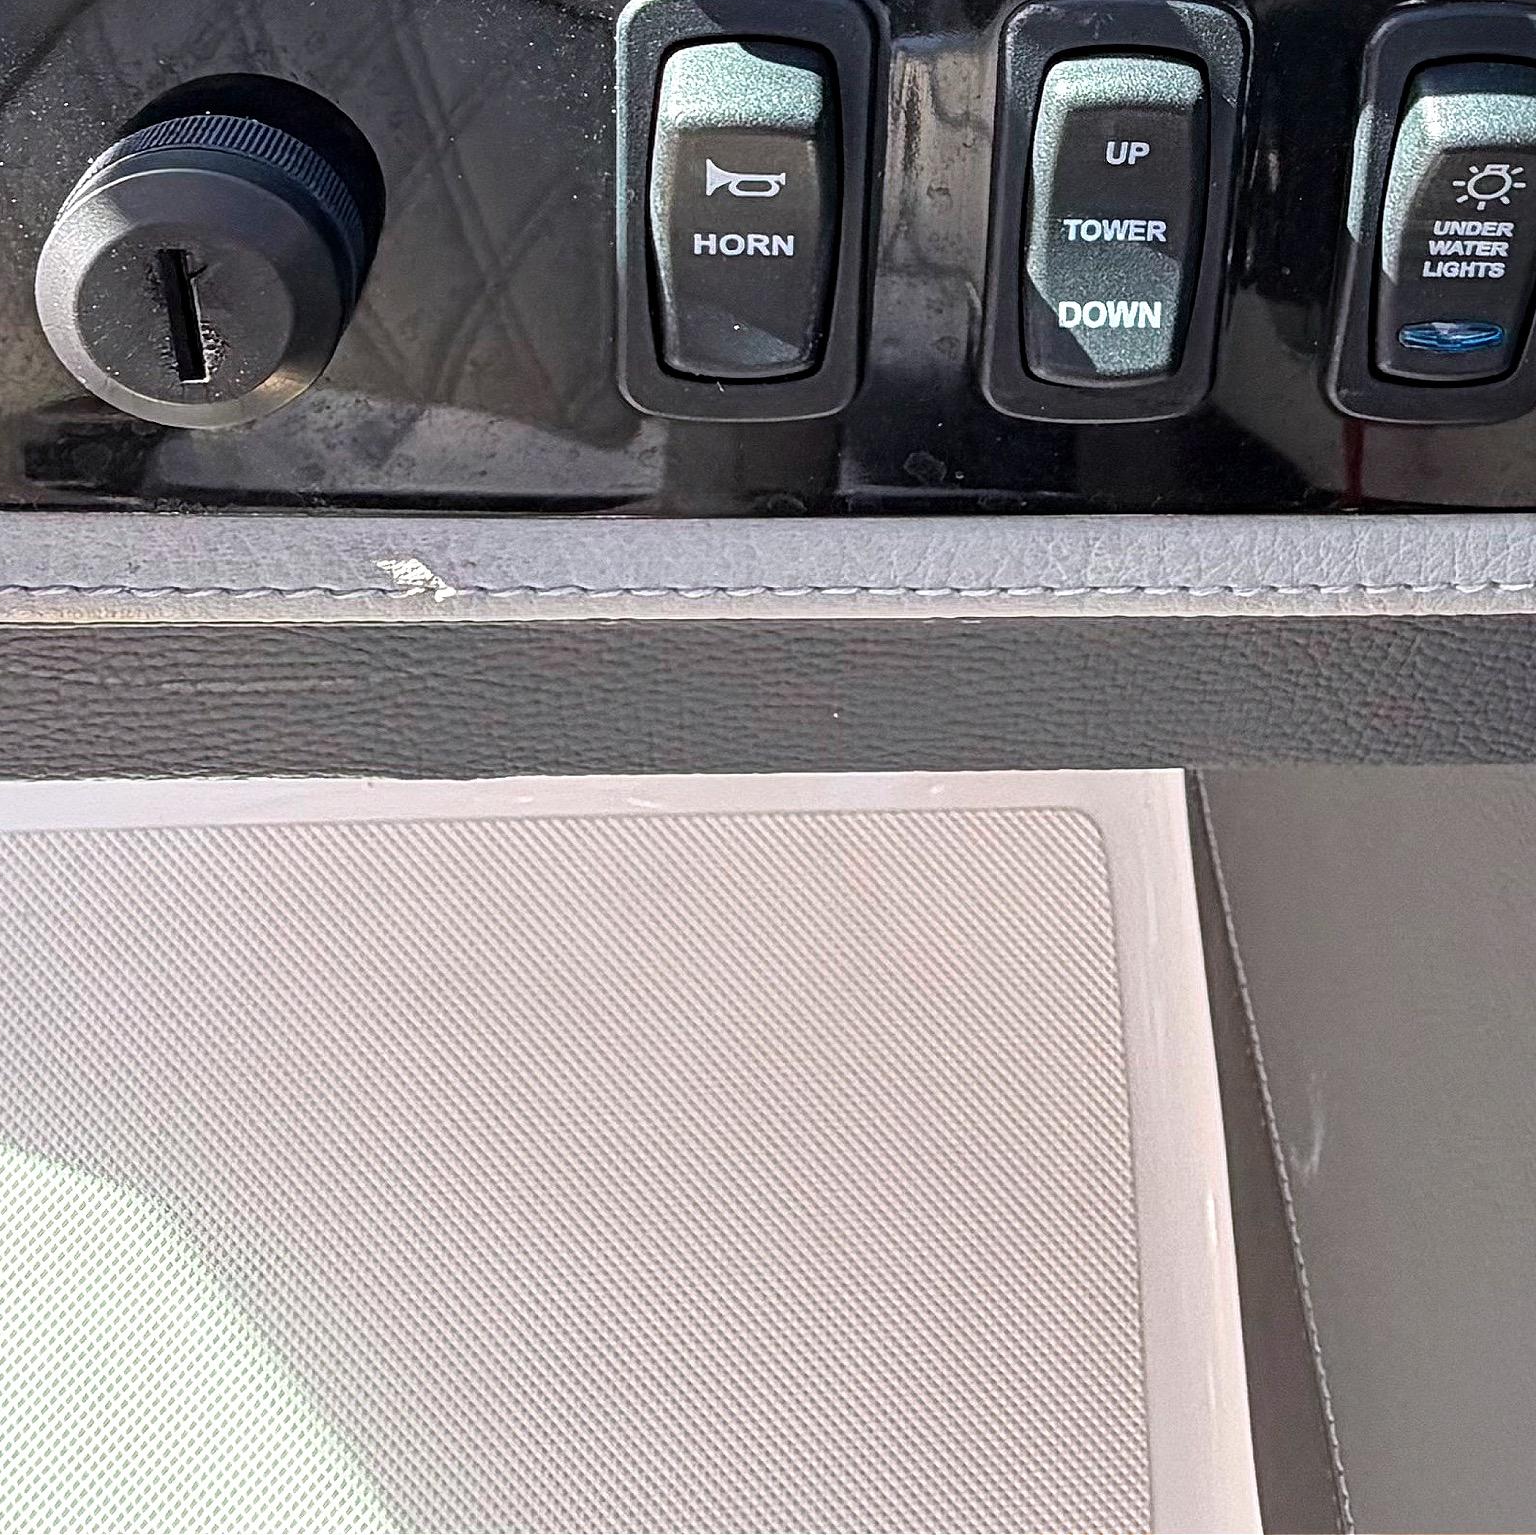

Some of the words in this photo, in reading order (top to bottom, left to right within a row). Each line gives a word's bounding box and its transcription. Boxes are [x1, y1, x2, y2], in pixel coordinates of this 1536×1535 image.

[1105, 141, 1150, 165] UP
[1063, 218, 1167, 242] TOWER
[1433, 220, 1515, 238] UNDER
[693, 233, 795, 256] HORN
[1428, 240, 1510, 257] WATER
[1422, 260, 1506, 278] LIGHTS
[1058, 300, 1162, 329] DOWN
